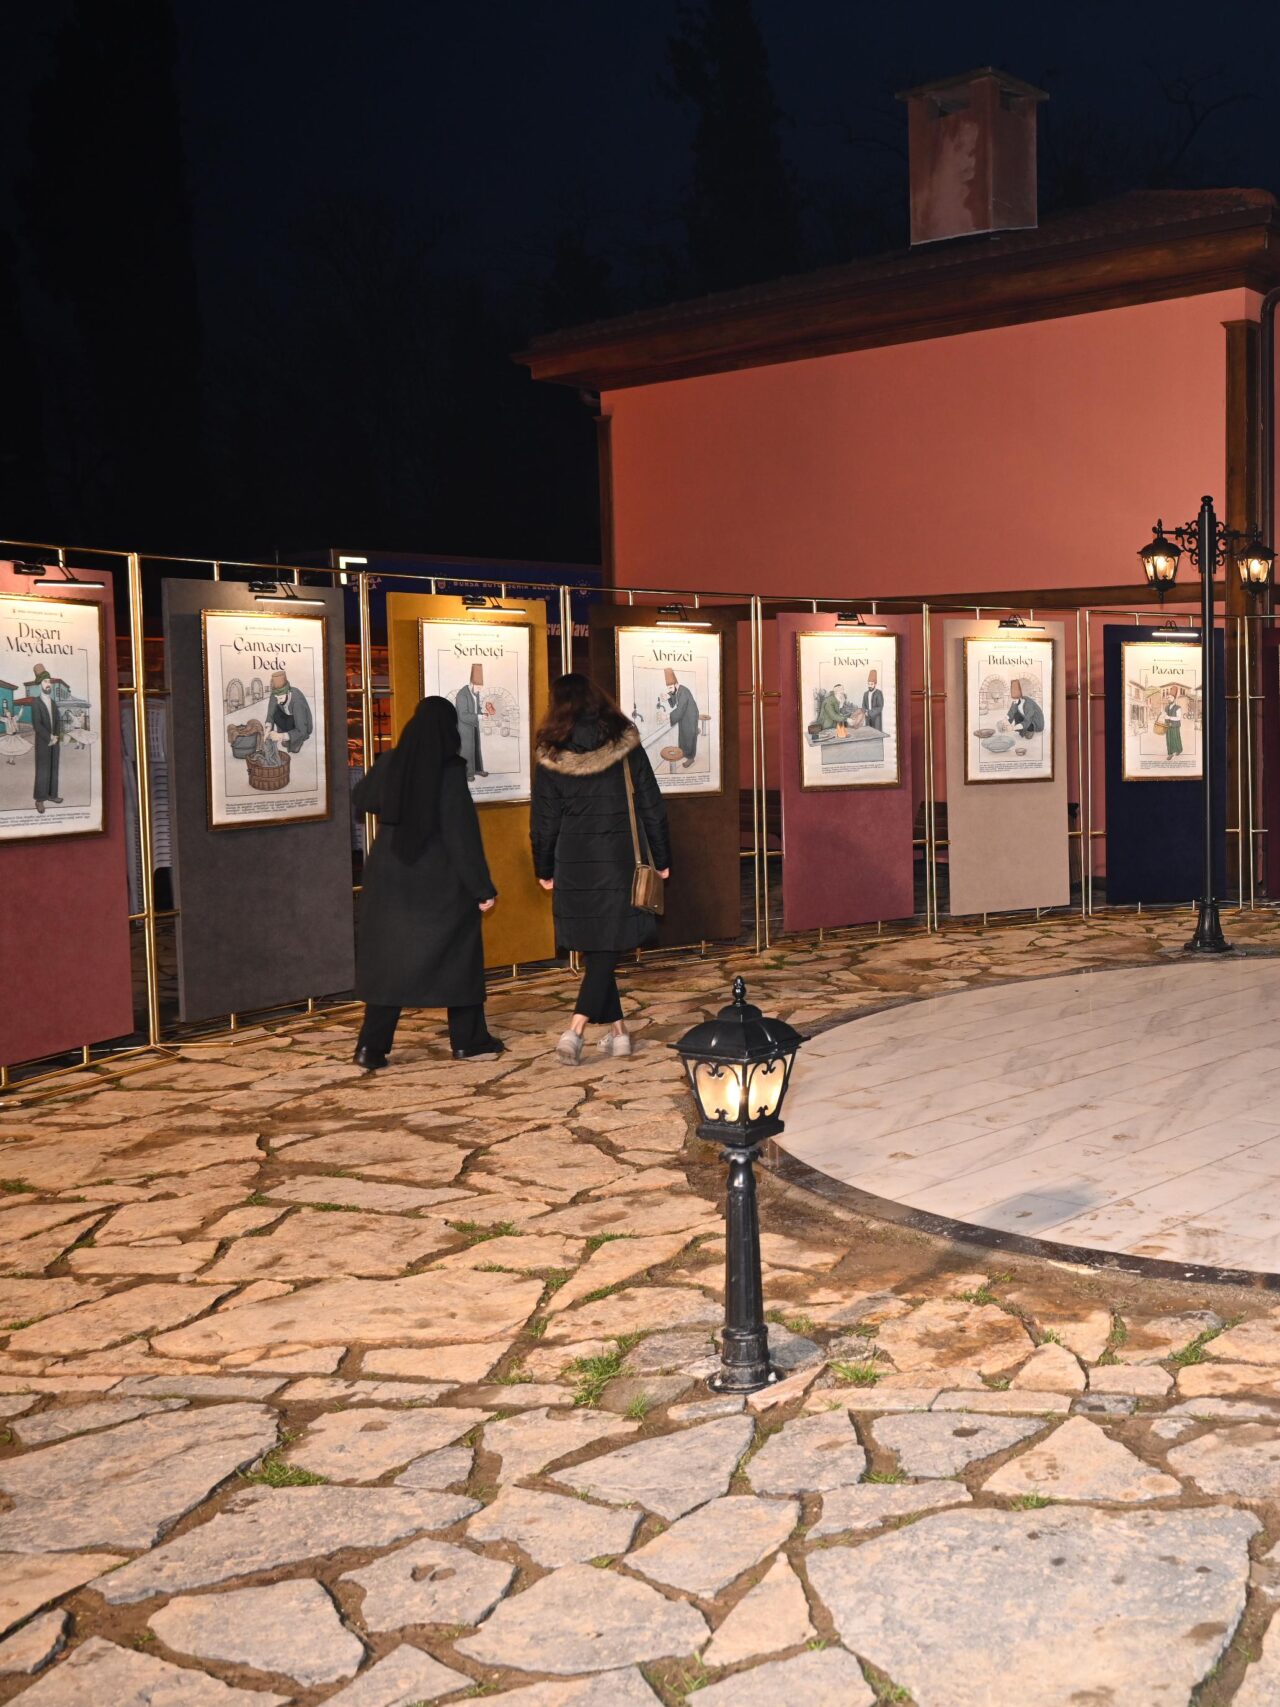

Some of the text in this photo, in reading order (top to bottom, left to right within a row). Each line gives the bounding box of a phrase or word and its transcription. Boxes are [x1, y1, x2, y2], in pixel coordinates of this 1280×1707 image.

[18, 622, 61, 642] Dışarı
[6, 636, 74, 656] Meydancı
[233, 636, 302, 655] Çamaşırcı
[453, 642, 504, 659] Şerbetçi
[252, 655, 286, 671] Dede
[649, 649, 693, 662] Abrizci
